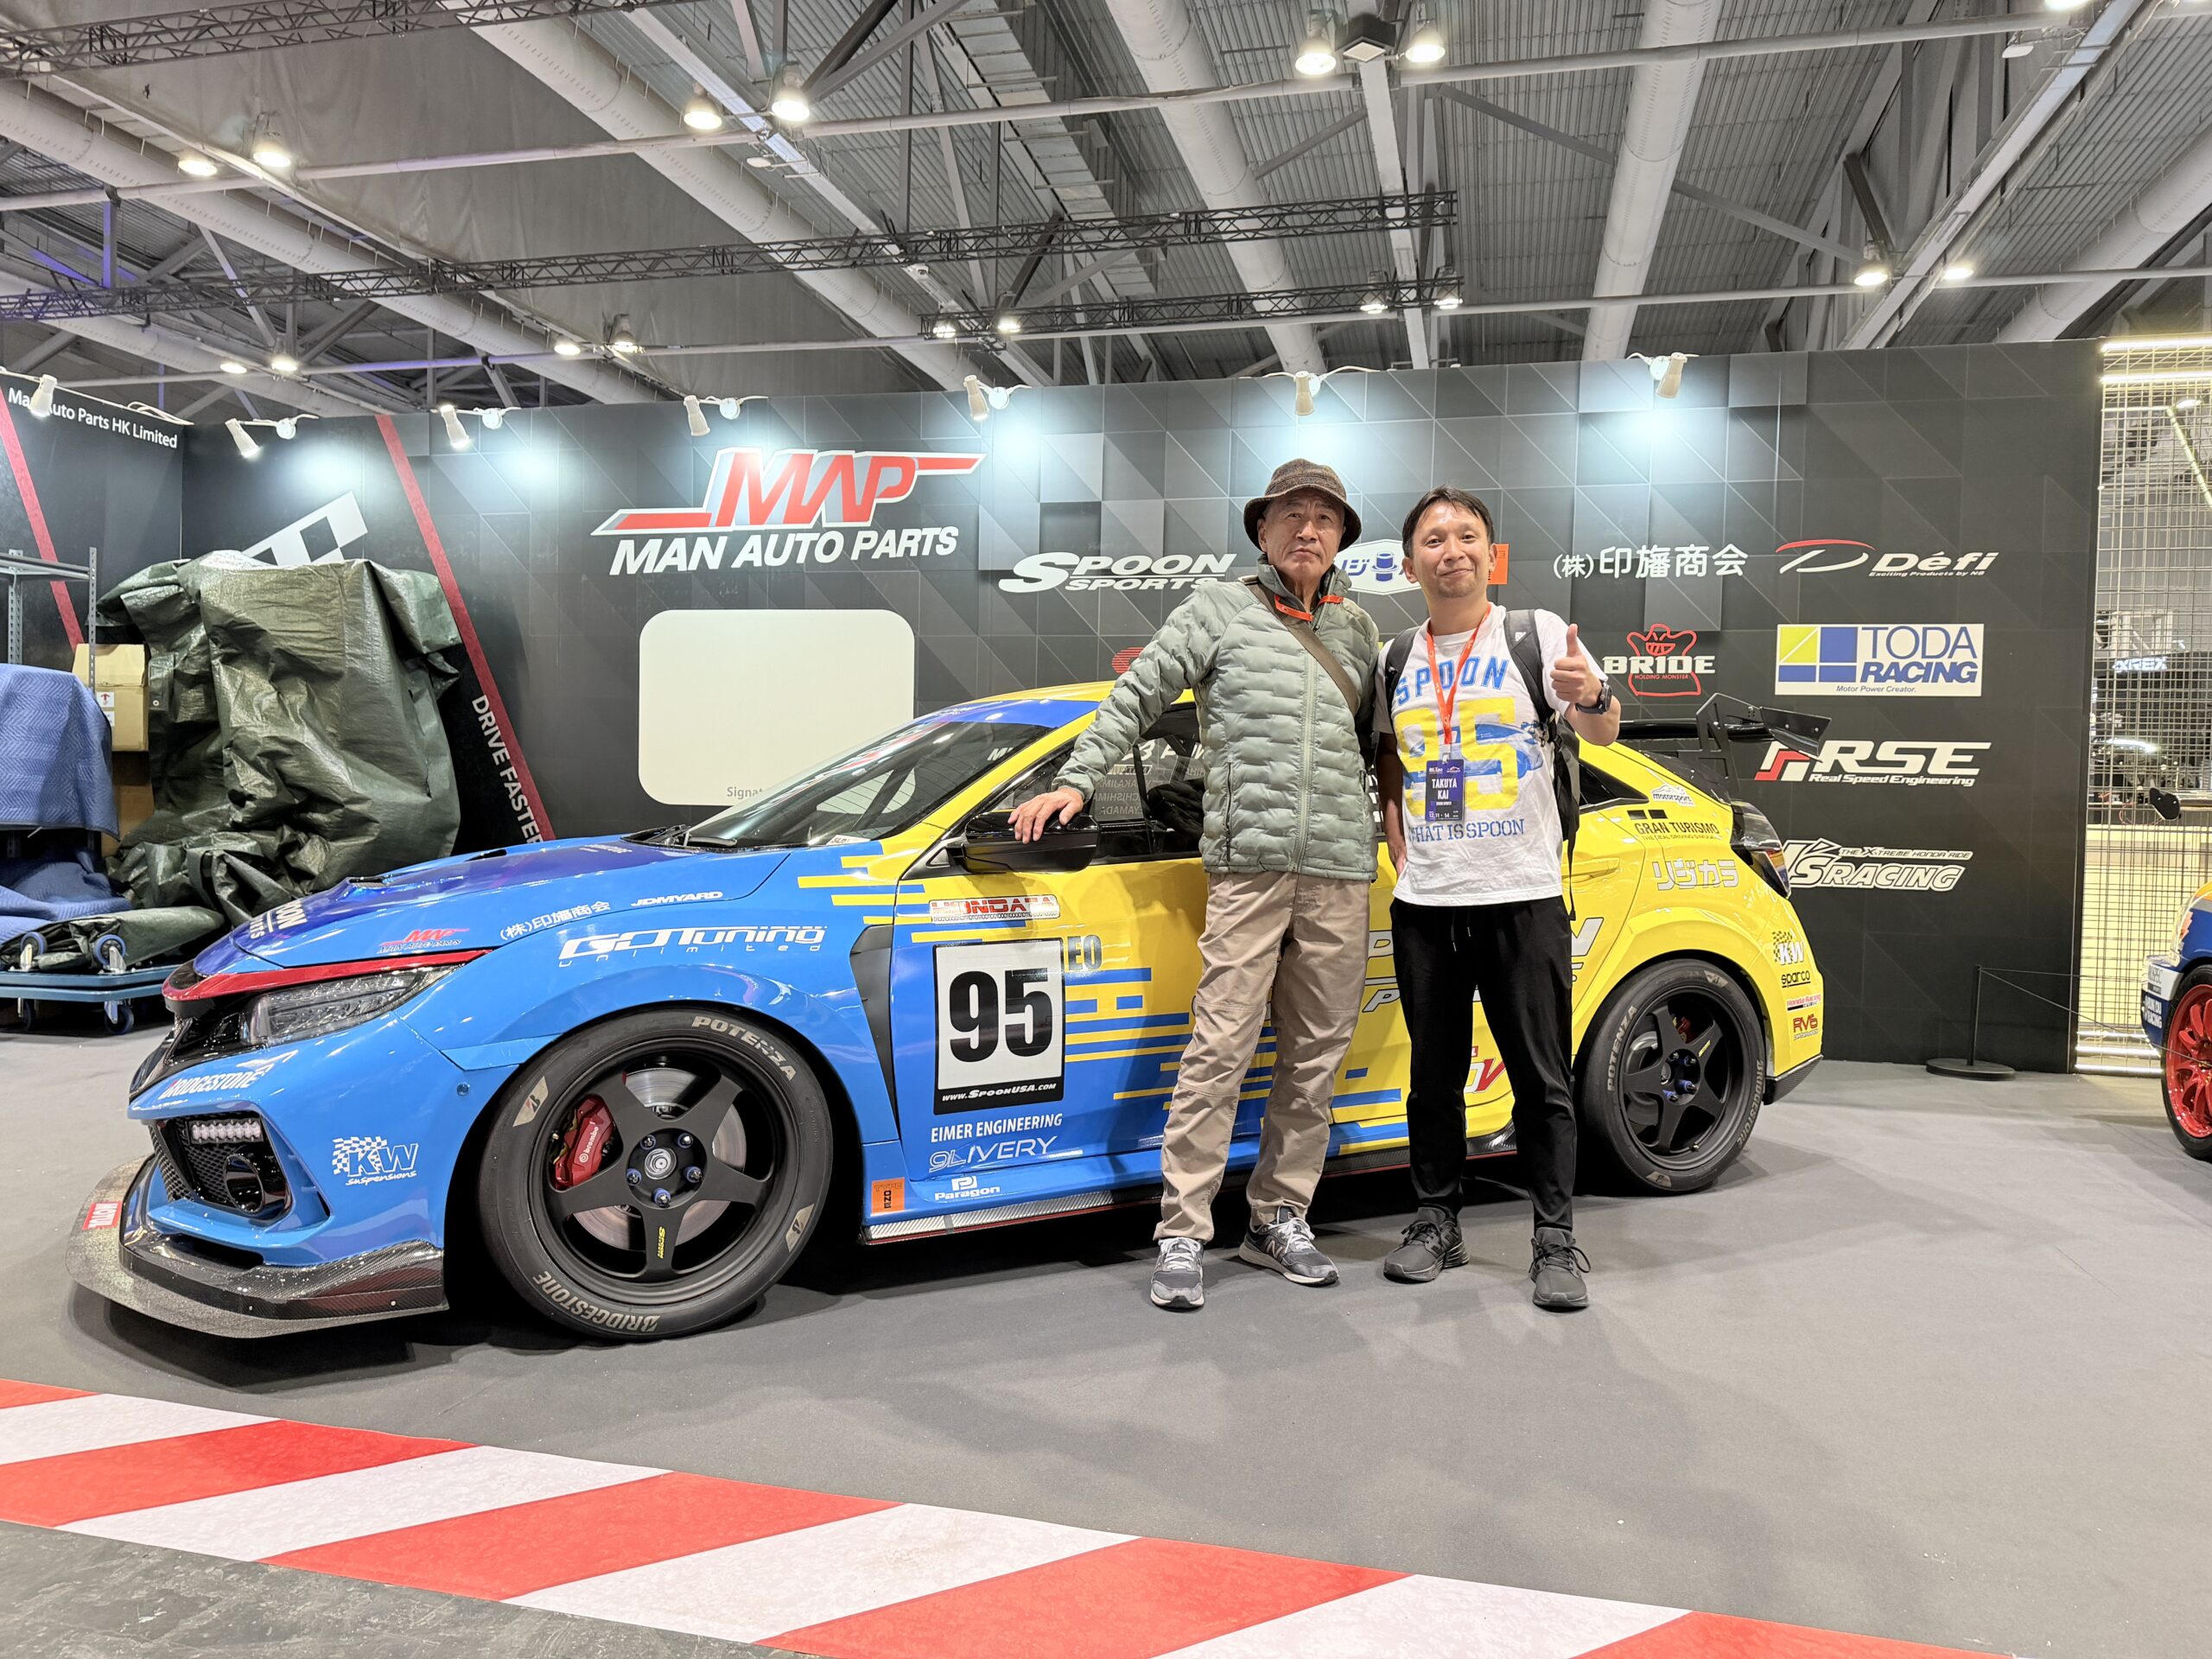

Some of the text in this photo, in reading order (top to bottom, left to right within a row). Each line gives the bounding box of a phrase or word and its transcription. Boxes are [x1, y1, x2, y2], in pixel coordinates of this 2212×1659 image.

[9, 387, 32, 407] Ma
[78, 411, 110, 430] Parts
[111, 417, 130, 435] HK
[132, 423, 178, 449] Limited
[609, 525, 959, 576] MAN AUTO PARTS
[1872, 550, 1999, 572] Défi
[998, 551, 1237, 594] SPOON
[1861, 625, 1978, 660] TODA
[1602, 655, 1716, 674] BRIDE
[1859, 661, 1979, 683] RACING
[1395, 655, 1510, 706] SPOON
[1886, 684, 1917, 693] Creator.
[472, 695, 512, 766] DRIVE
[1394, 696, 1519, 817] 95
[1812, 740, 1992, 776] RSE
[1432, 778, 1458, 789] TAKUYA
[1437, 789, 1449, 800] KAI
[1808, 773, 1975, 787] Real Speed Engineering
[1447, 823, 1465, 840] IS
[1466, 819, 1525, 839] SPOON
[1634, 822, 1719, 835] GRAN TURISMO
[1912, 850, 1946, 859] HONDA
[1651, 858, 1739, 892] リジカラ
[1822, 862, 1966, 892] RACING
[631, 891, 724, 907] JDMYARD
[931, 896, 1056, 916] HONDATA
[1779, 941, 1805, 966] KW
[1781, 970, 1811, 988] sparco
[948, 967, 1053, 1063] 95
[692, 1015, 797, 1081] POTENZA
[1607, 1005, 1637, 1092] POTENZA
[158, 1071, 261, 1100] BRIDGESTONE
[1737, 1059, 1764, 1148] BRIDGESTONE
[582, 1126, 599, 1154] brembo
[931, 1113, 1063, 1143] EIMER ENGINEERING
[346, 1142, 419, 1178] KW
[345, 1171, 418, 1186] suspensions
[934, 1185, 1001, 1201] Paragon
[531, 1271, 662, 1332] BRIDGESTONE
